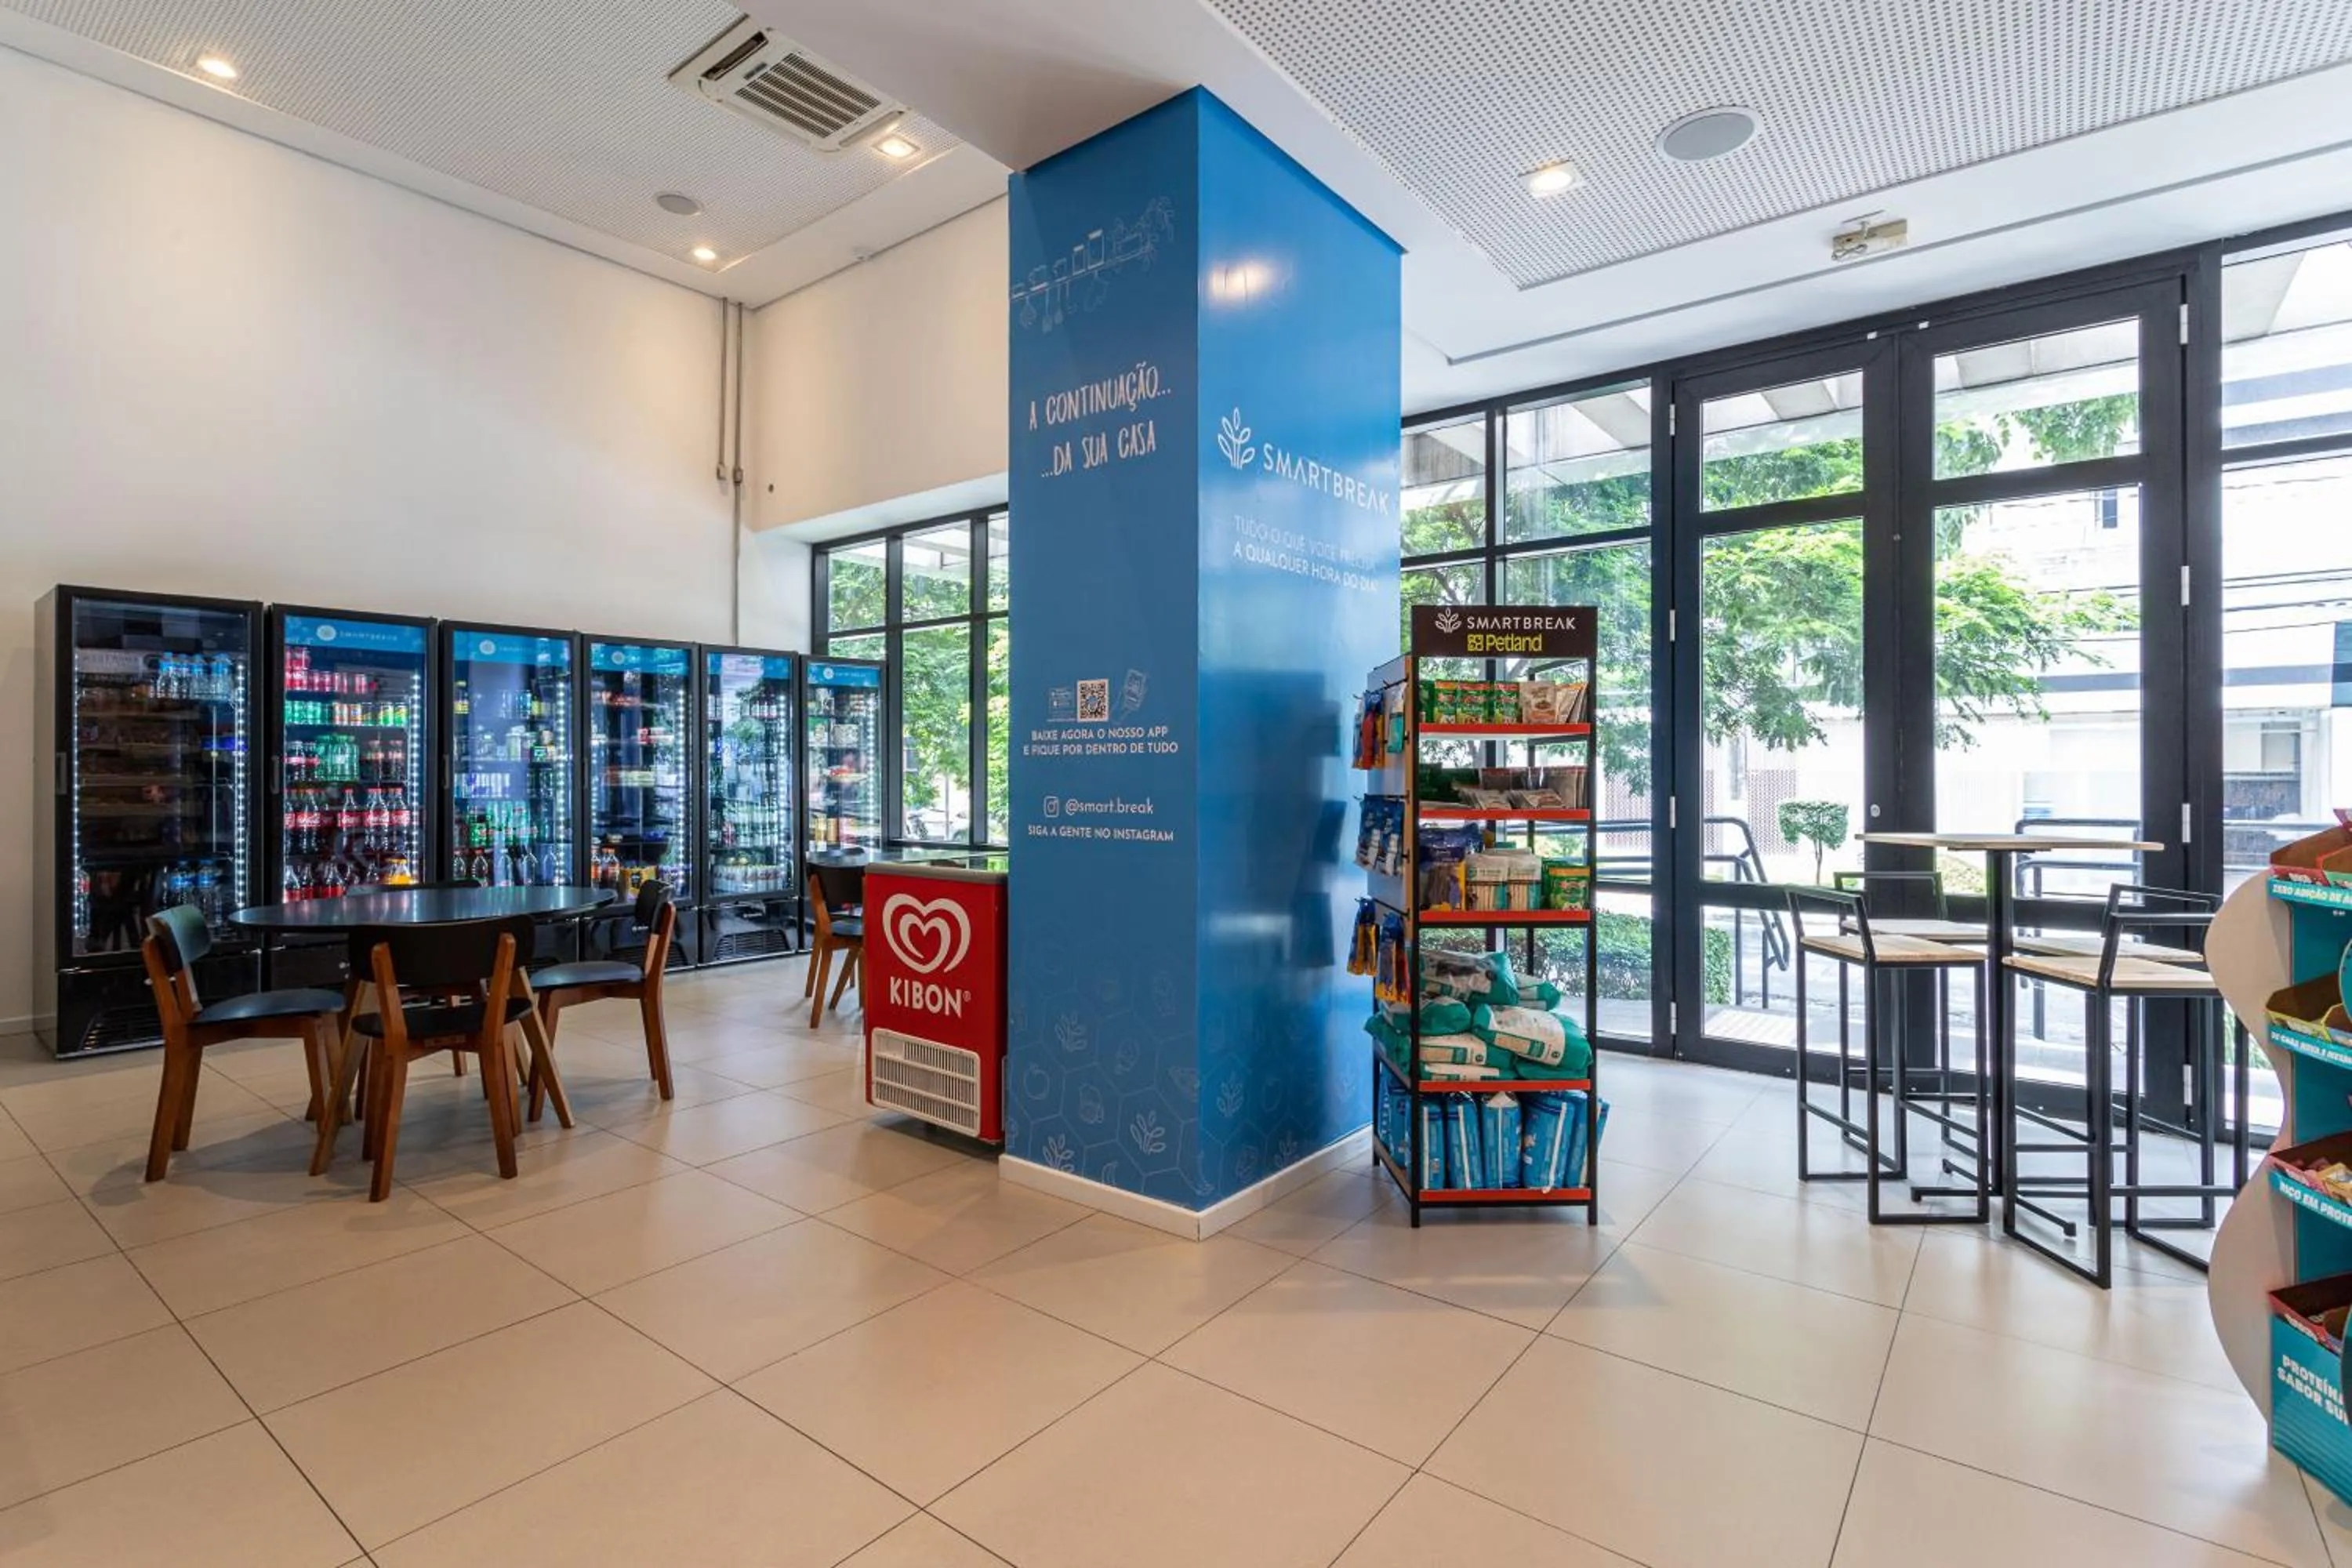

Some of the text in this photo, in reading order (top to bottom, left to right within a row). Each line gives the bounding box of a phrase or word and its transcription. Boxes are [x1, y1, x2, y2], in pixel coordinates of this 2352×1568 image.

[1029, 361, 1171, 431] A CONTINUAÇÃO...
[1082, 432, 1108, 469] SUA
[1118, 419, 1156, 459] CASA
[1263, 442, 1390, 516] SMARTBREAK
[1233, 542, 1242, 557] A
[1246, 544, 1309, 575] QUALQUER
[1312, 562, 1341, 584] HORA
[1344, 572, 1358, 590] DO
[1467, 617, 1576, 630] SMARTBREAK
[1486, 633, 1543, 652] Petland
[1031, 726, 1168, 741] BAIXE AGORA O NOSSO APP
[1023, 742, 1178, 756] E FIQUE POR DENTRO DE TUDO
[1065, 797, 1154, 815] @smart.break
[1028, 825, 1174, 841] SIGA A GENTE NO INSTAGRAM
[2280, 1181, 2301, 1200] RICO
[2277, 1367, 2322, 1407] SABOR
